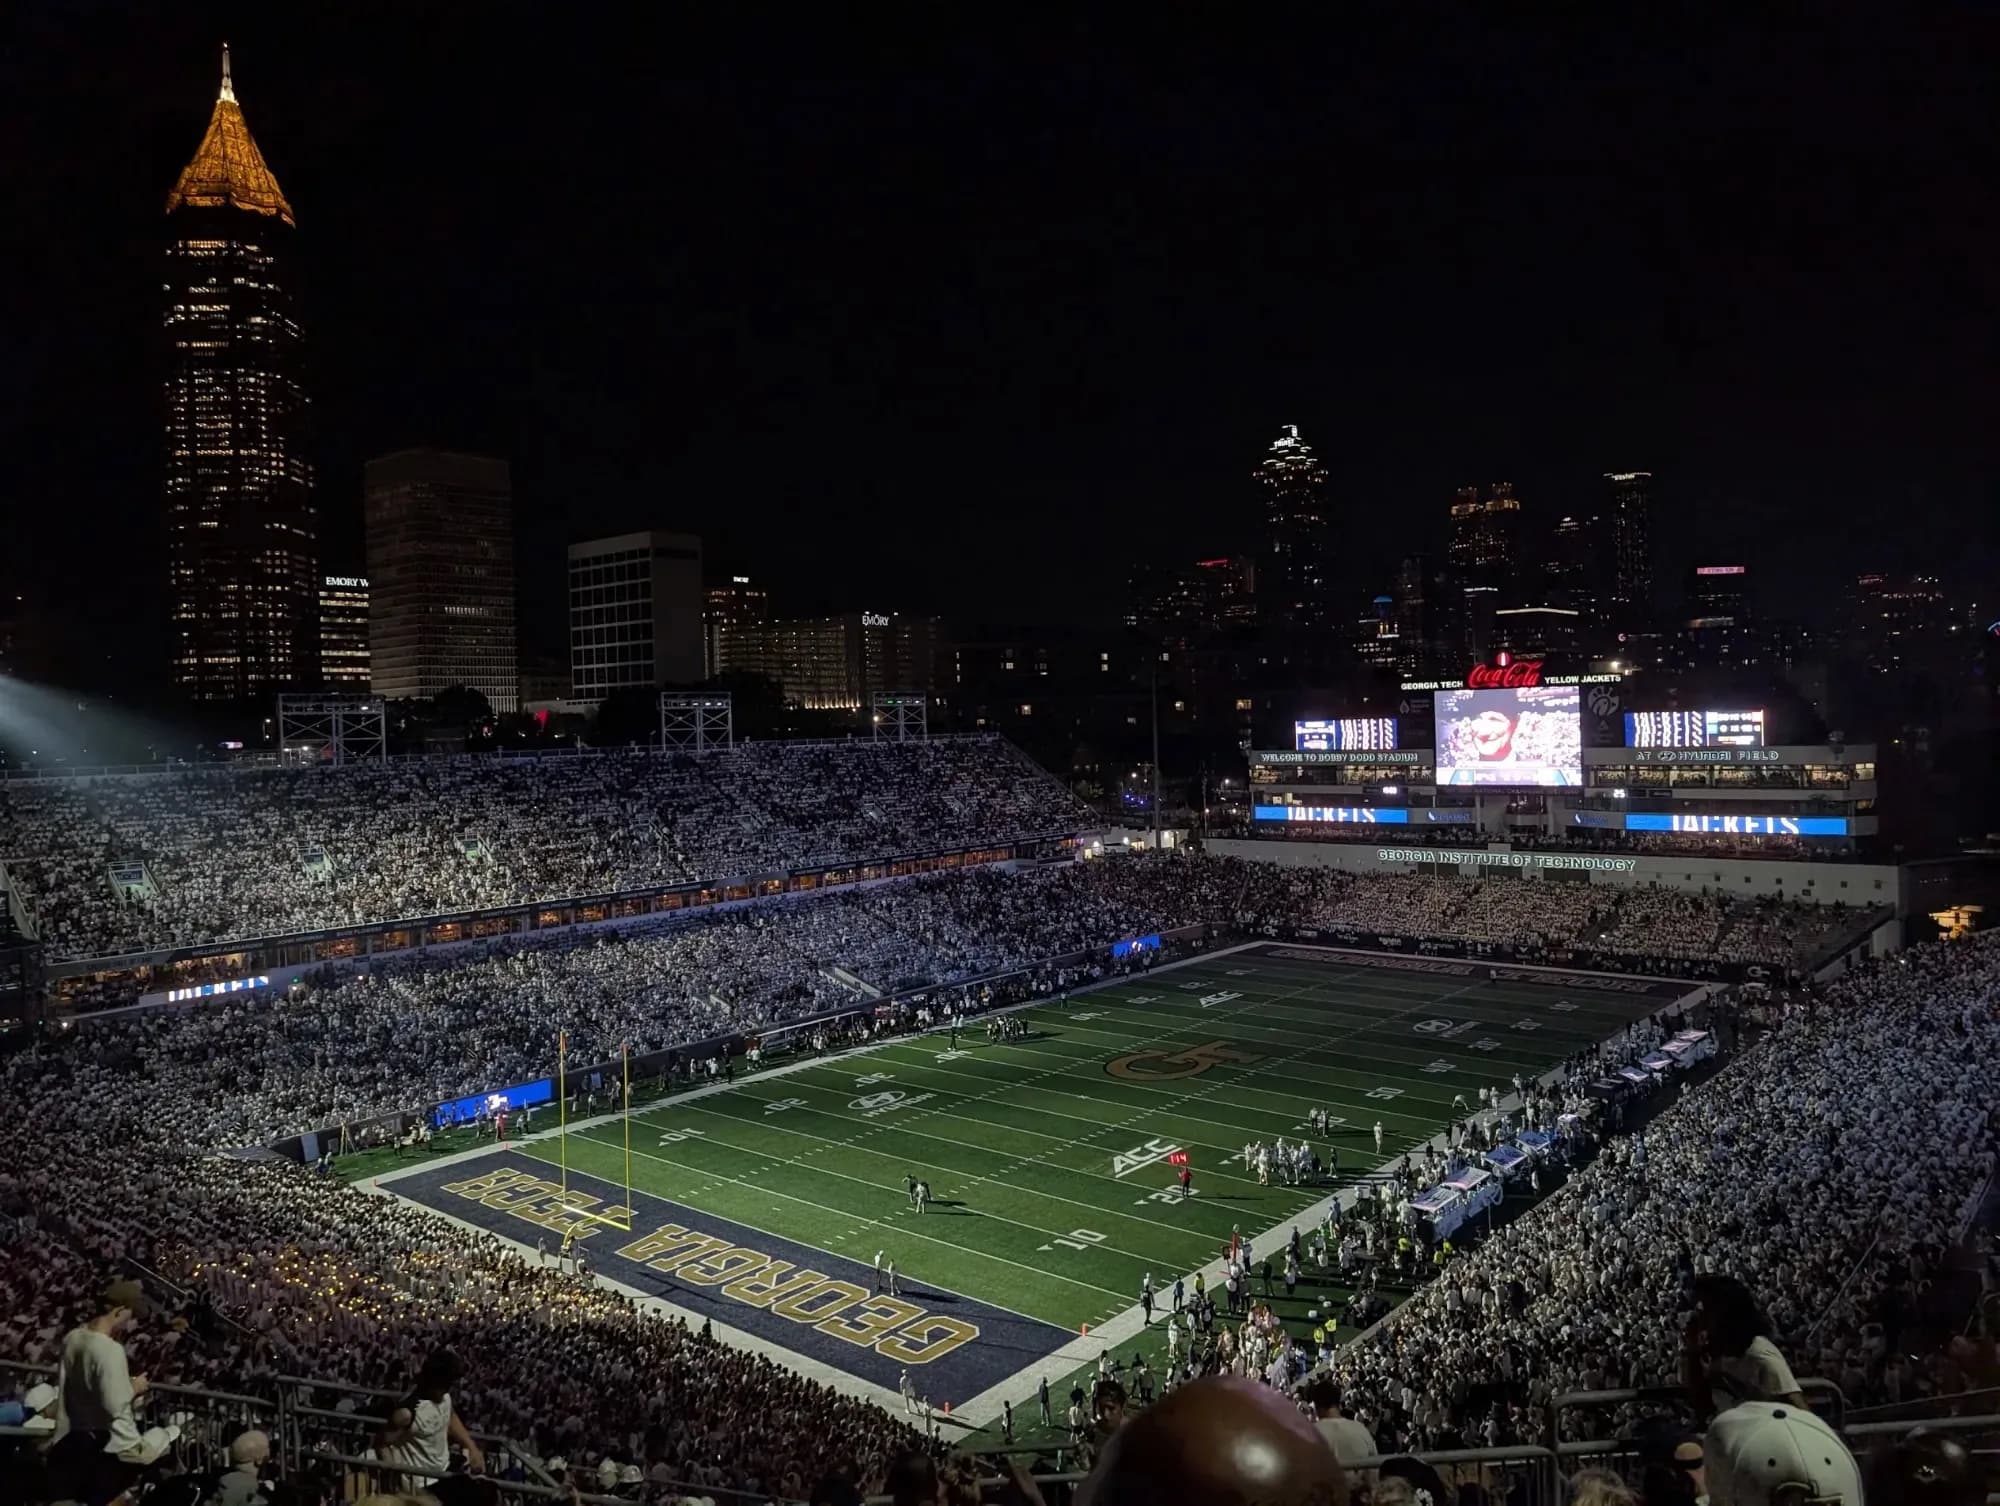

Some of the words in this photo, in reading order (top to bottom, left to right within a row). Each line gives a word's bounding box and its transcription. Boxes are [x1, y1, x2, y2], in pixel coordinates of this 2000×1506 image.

[326, 576, 358, 587] EMORY
[862, 614, 889, 626] EMORY
[1401, 681, 1439, 691] GEORGIA
[1440, 680, 1464, 689] TECH
[1544, 675, 1580, 685] YELLOW
[1581, 674, 1622, 684] JACKETS
[1261, 753, 1303, 763] WELCOME
[1304, 753, 1317, 763] TO
[1318, 753, 1348, 763] BOBBY
[1350, 753, 1376, 763] DODD
[1378, 753, 1418, 763] STADIUM
[1636, 752, 1652, 761] AT
[1678, 751, 1732, 762] HYUNDAI
[1737, 751, 1780, 761] FIELD
[1376, 849, 1436, 863] GEORGIA
[1438, 851, 1510, 867] INSTITUTE
[1511, 854, 1532, 867] OF
[1535, 855, 1636, 872] TECHNOLOGY
[1365, 1086, 1406, 1101] 50
[1111, 1138, 1178, 1174] ACC
[1054, 1228, 1108, 1251] 10
[614, 1223, 980, 1364] GEORGIA
